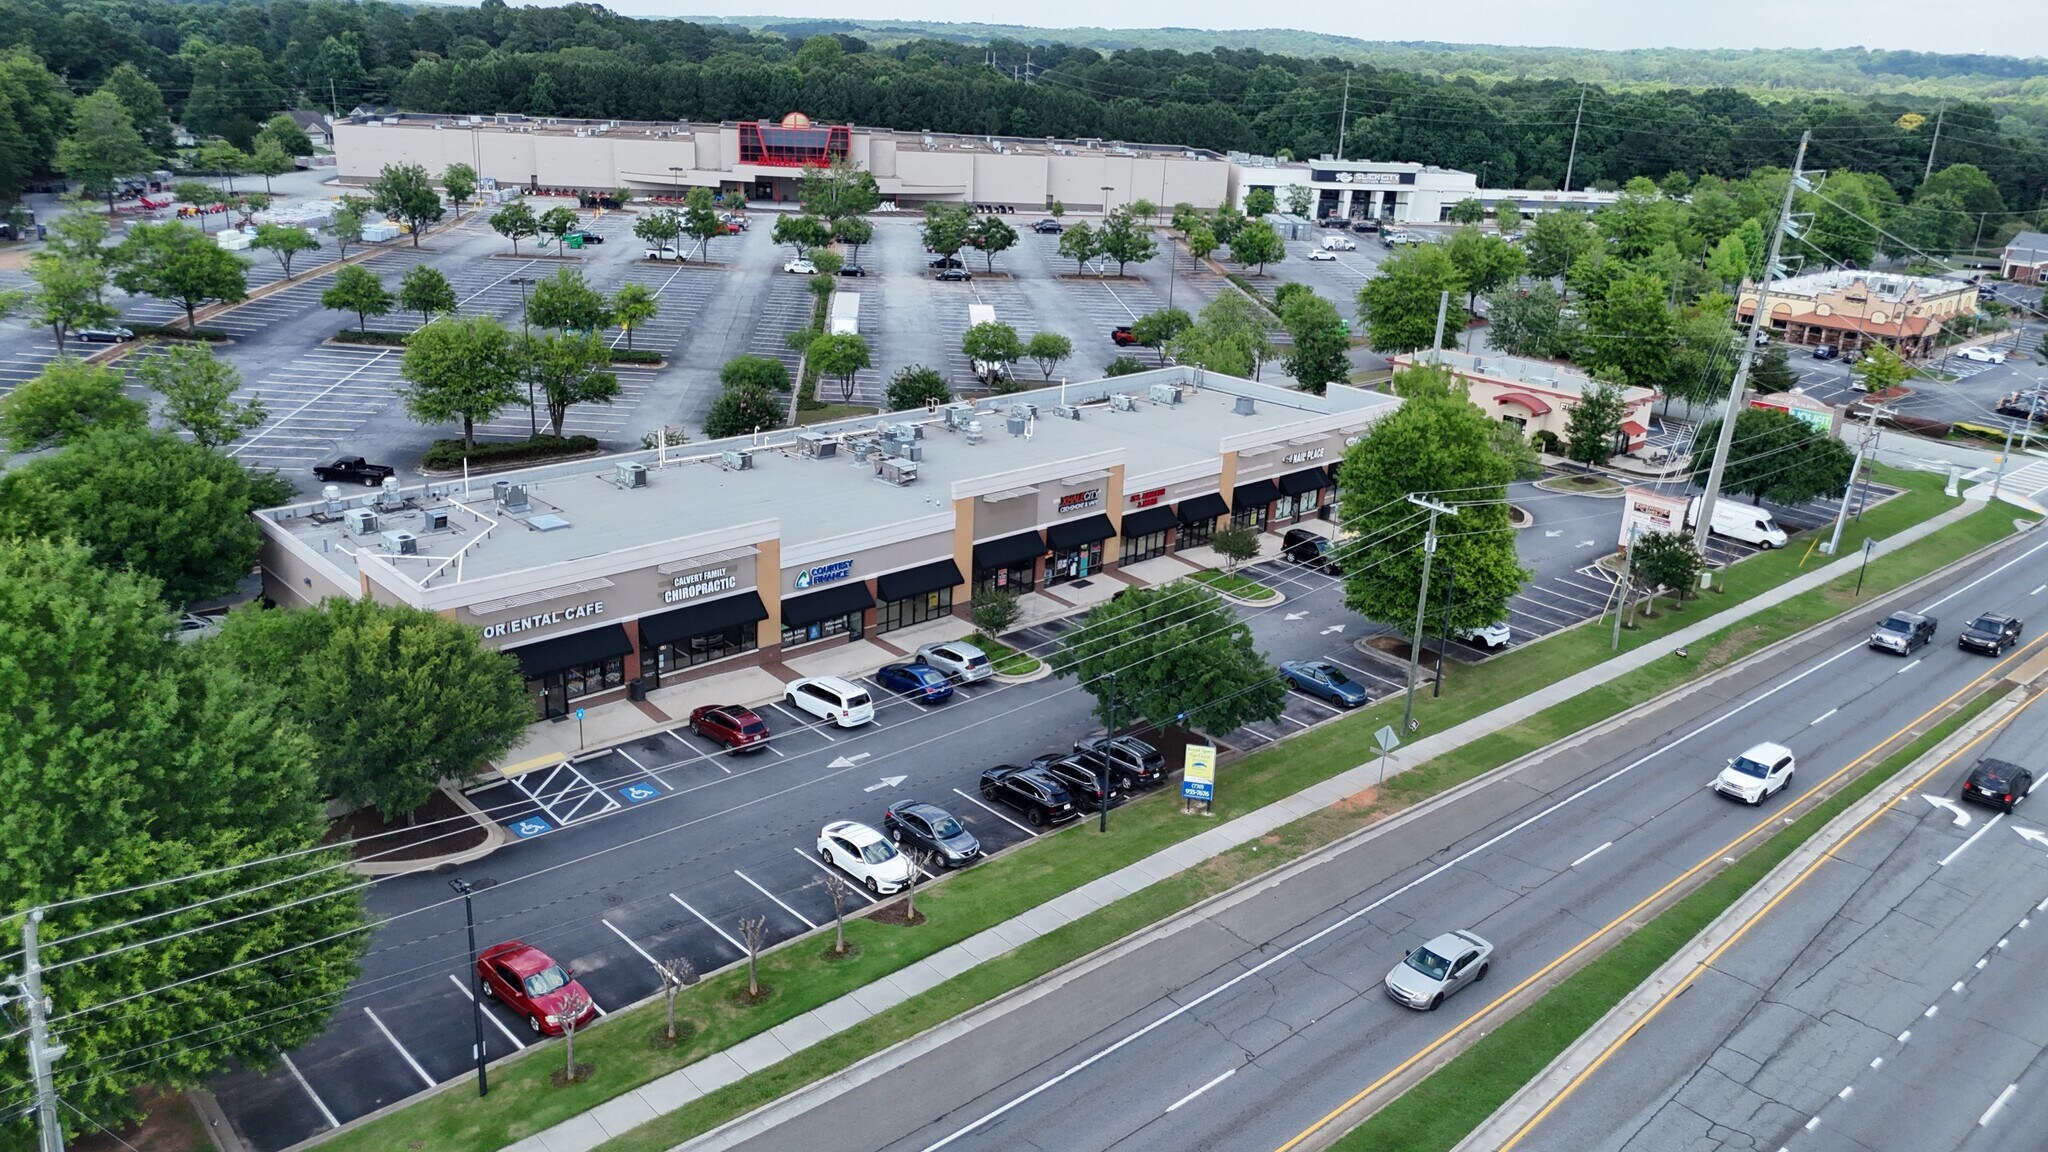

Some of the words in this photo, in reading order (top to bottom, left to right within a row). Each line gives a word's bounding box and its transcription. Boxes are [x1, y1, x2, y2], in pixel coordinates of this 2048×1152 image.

[1307, 447, 1325, 460] PLACE
[810, 558, 854, 576] COURTESY
[673, 571, 703, 587] CALVERT
[703, 567, 727, 580] FAMILY
[812, 569, 850, 586] FINANCE
[664, 576, 736, 603] CHIROPRACTIC
[483, 610, 560, 639] ORIENTAL
[564, 601, 604, 620] CAFE
